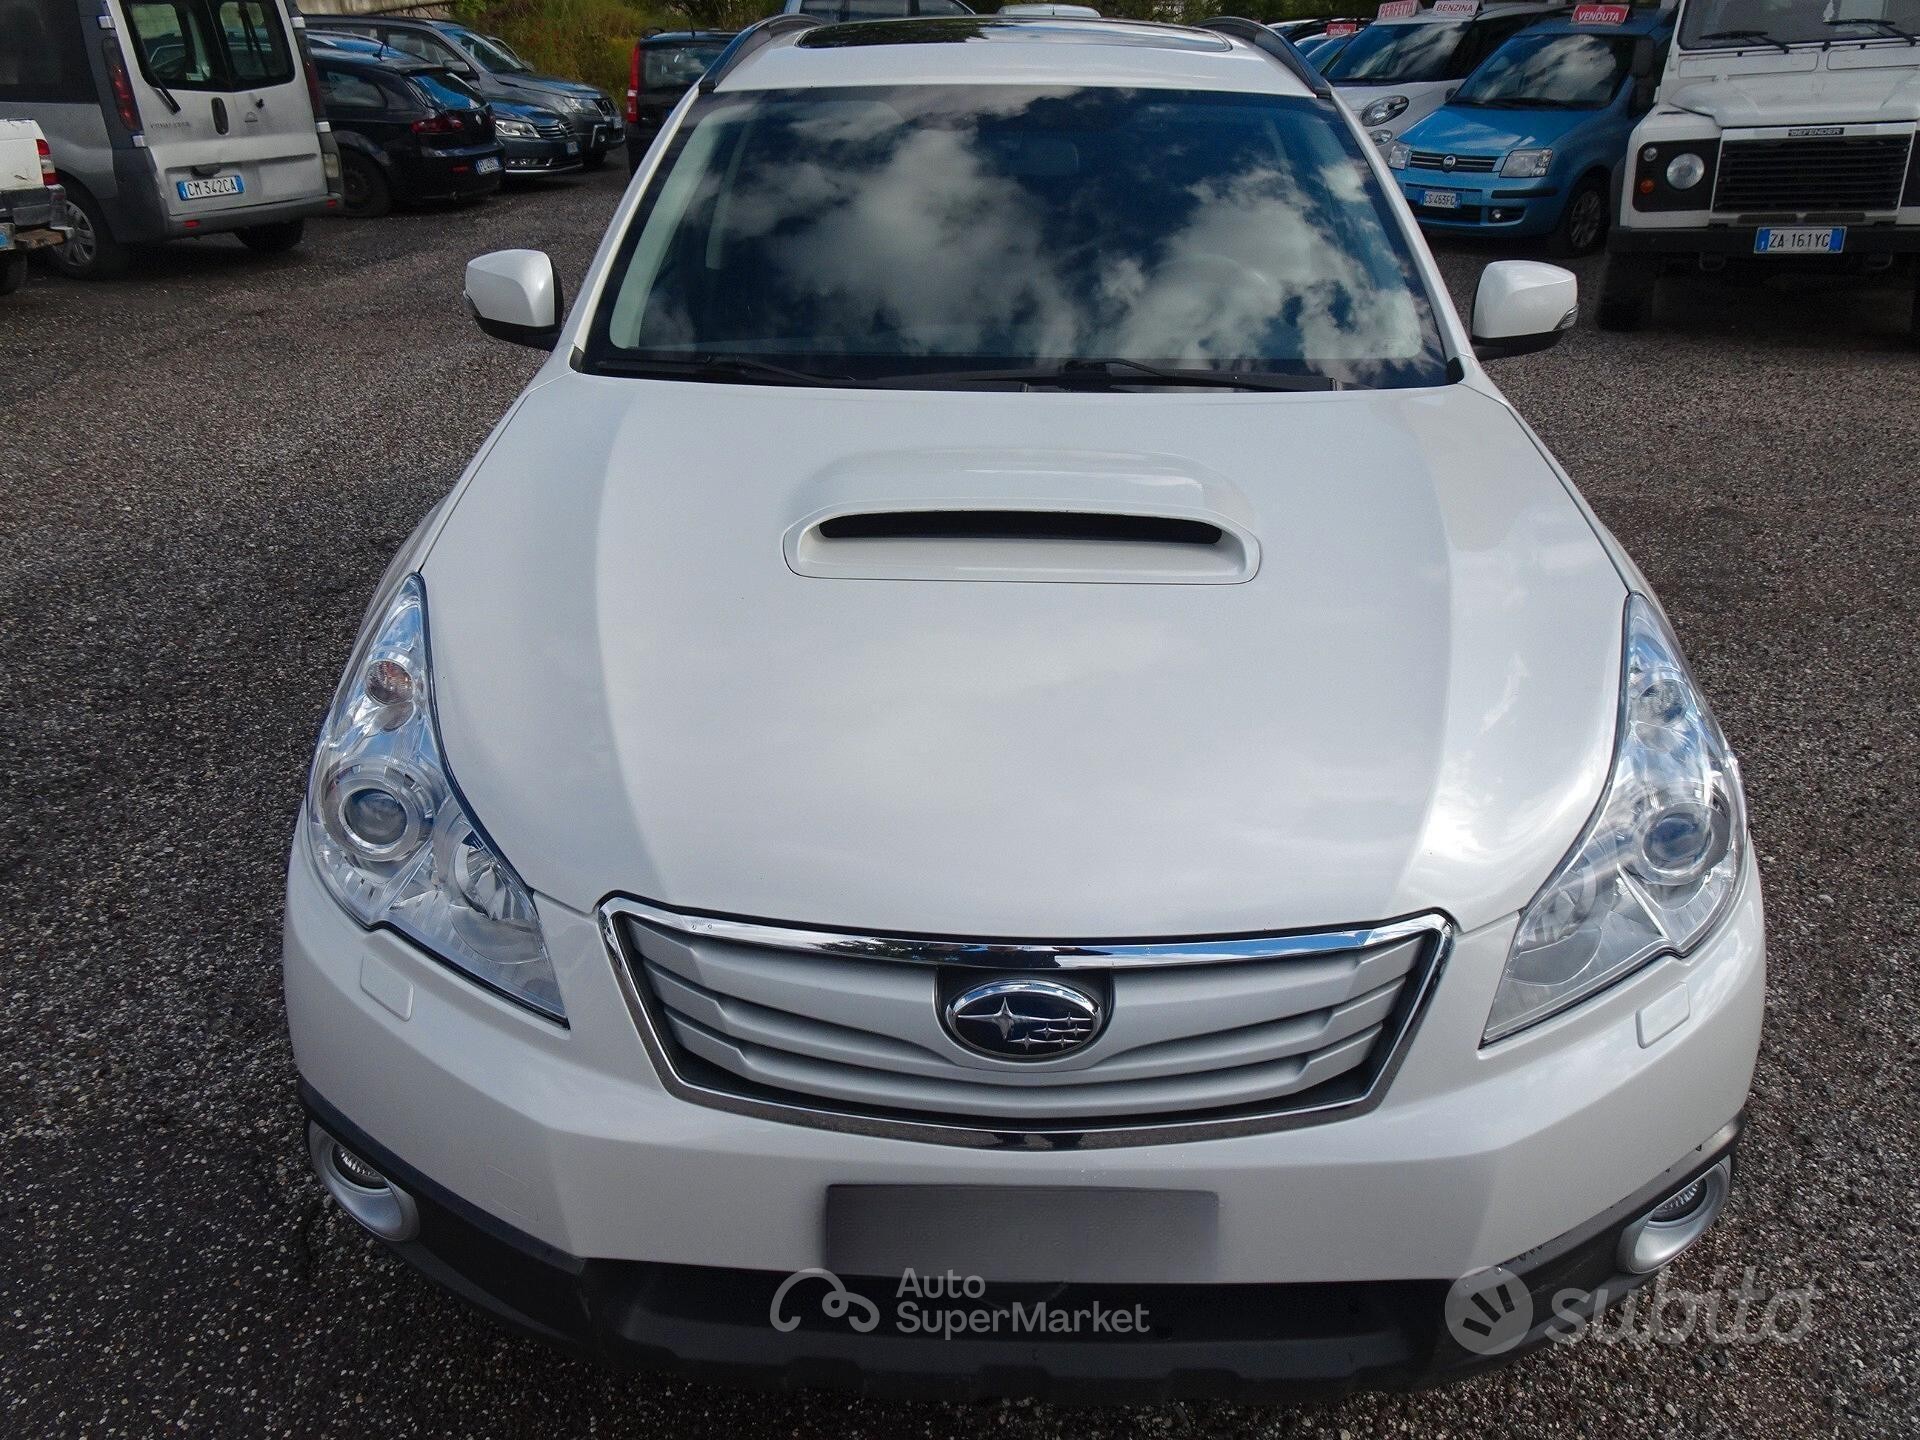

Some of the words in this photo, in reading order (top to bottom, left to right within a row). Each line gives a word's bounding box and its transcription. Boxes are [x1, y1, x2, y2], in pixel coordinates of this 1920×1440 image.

[1437, 4, 1473, 12] BENZINA
[1578, 11, 1620, 21] VENDUTA
[1791, 128, 1842, 136] DEFENDER
[187, 182, 203, 197] CM
[1768, 233, 1785, 249] ZA
